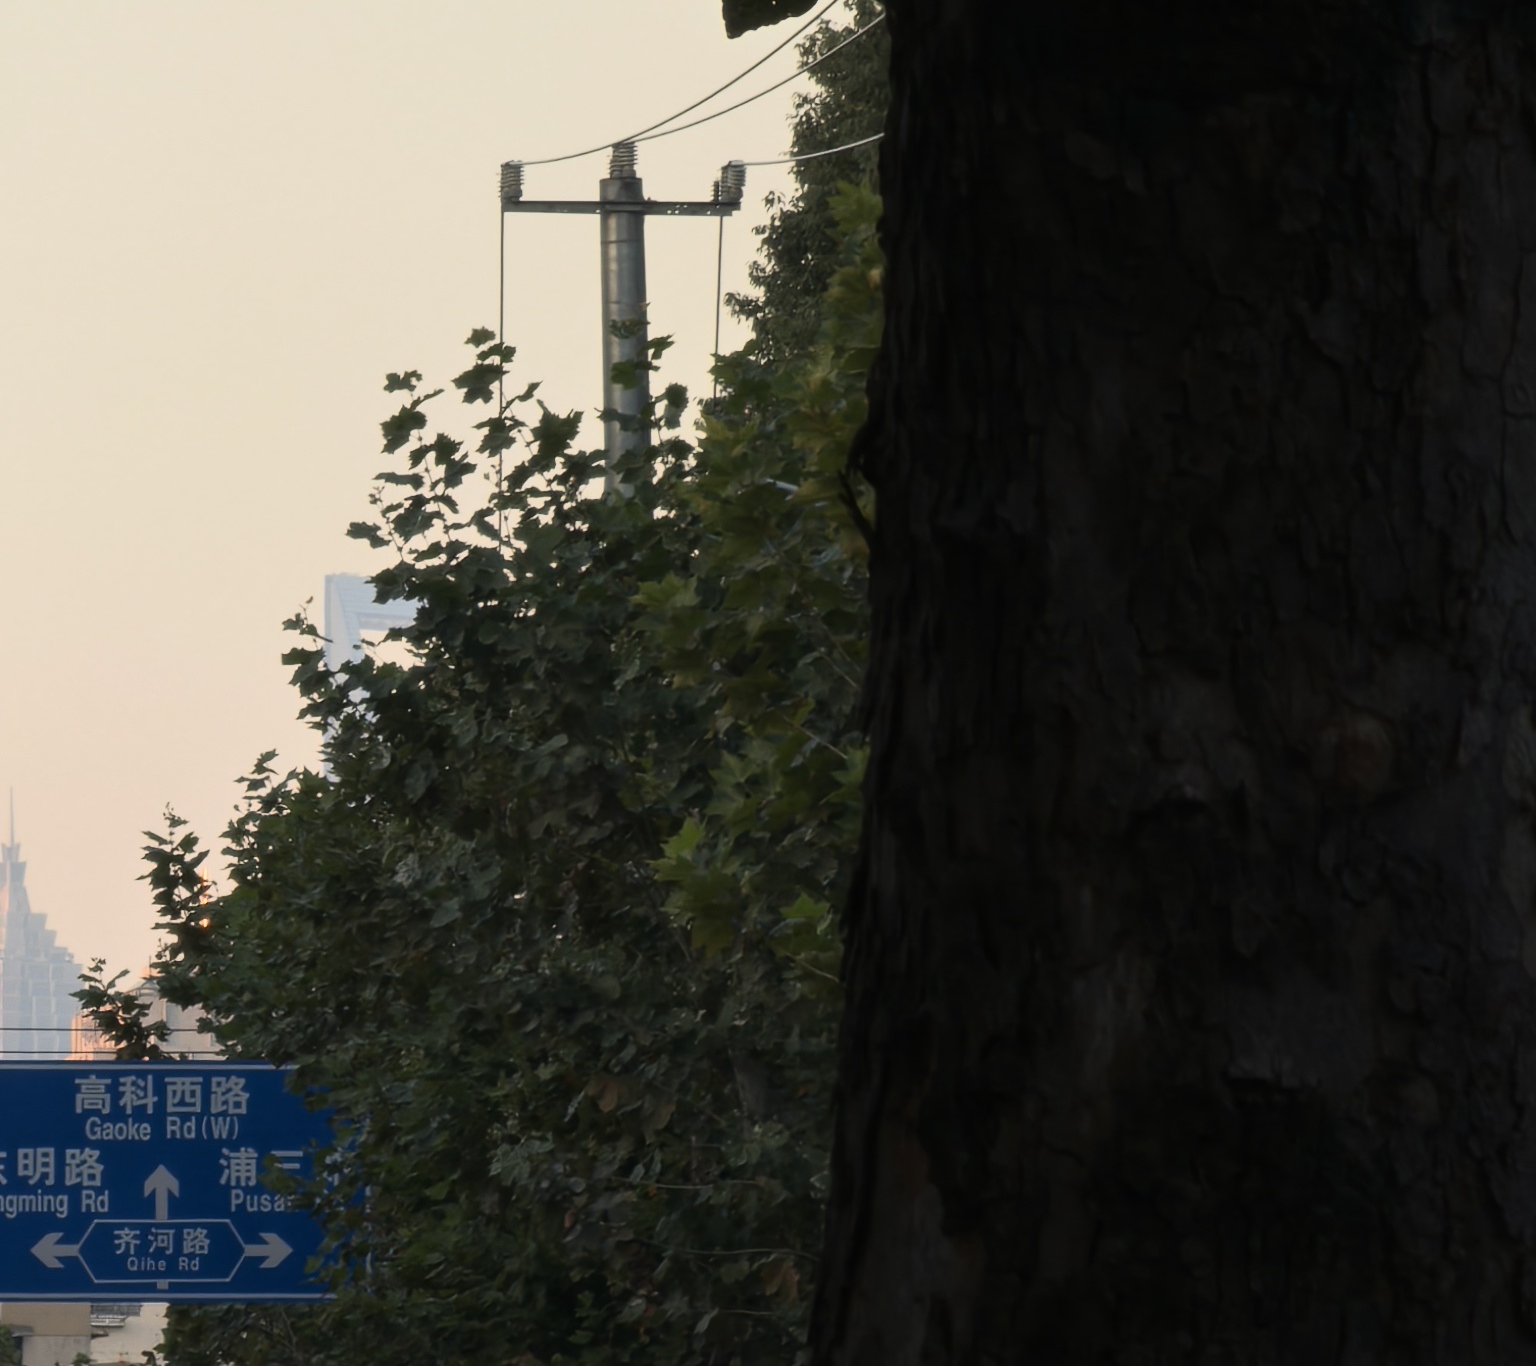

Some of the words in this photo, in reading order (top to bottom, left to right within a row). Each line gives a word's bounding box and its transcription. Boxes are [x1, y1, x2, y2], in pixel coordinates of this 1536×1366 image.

[74, 1075, 250, 1115] 高科西路
[85, 1116, 152, 1141] Gaoke
[219, 1146, 348, 1187] 浦三
[81, 1190, 109, 1213] Rd
[113, 1227, 211, 1256] 齐河路
[127, 1256, 167, 1272] Qihe
[179, 1256, 200, 1271] Rd
